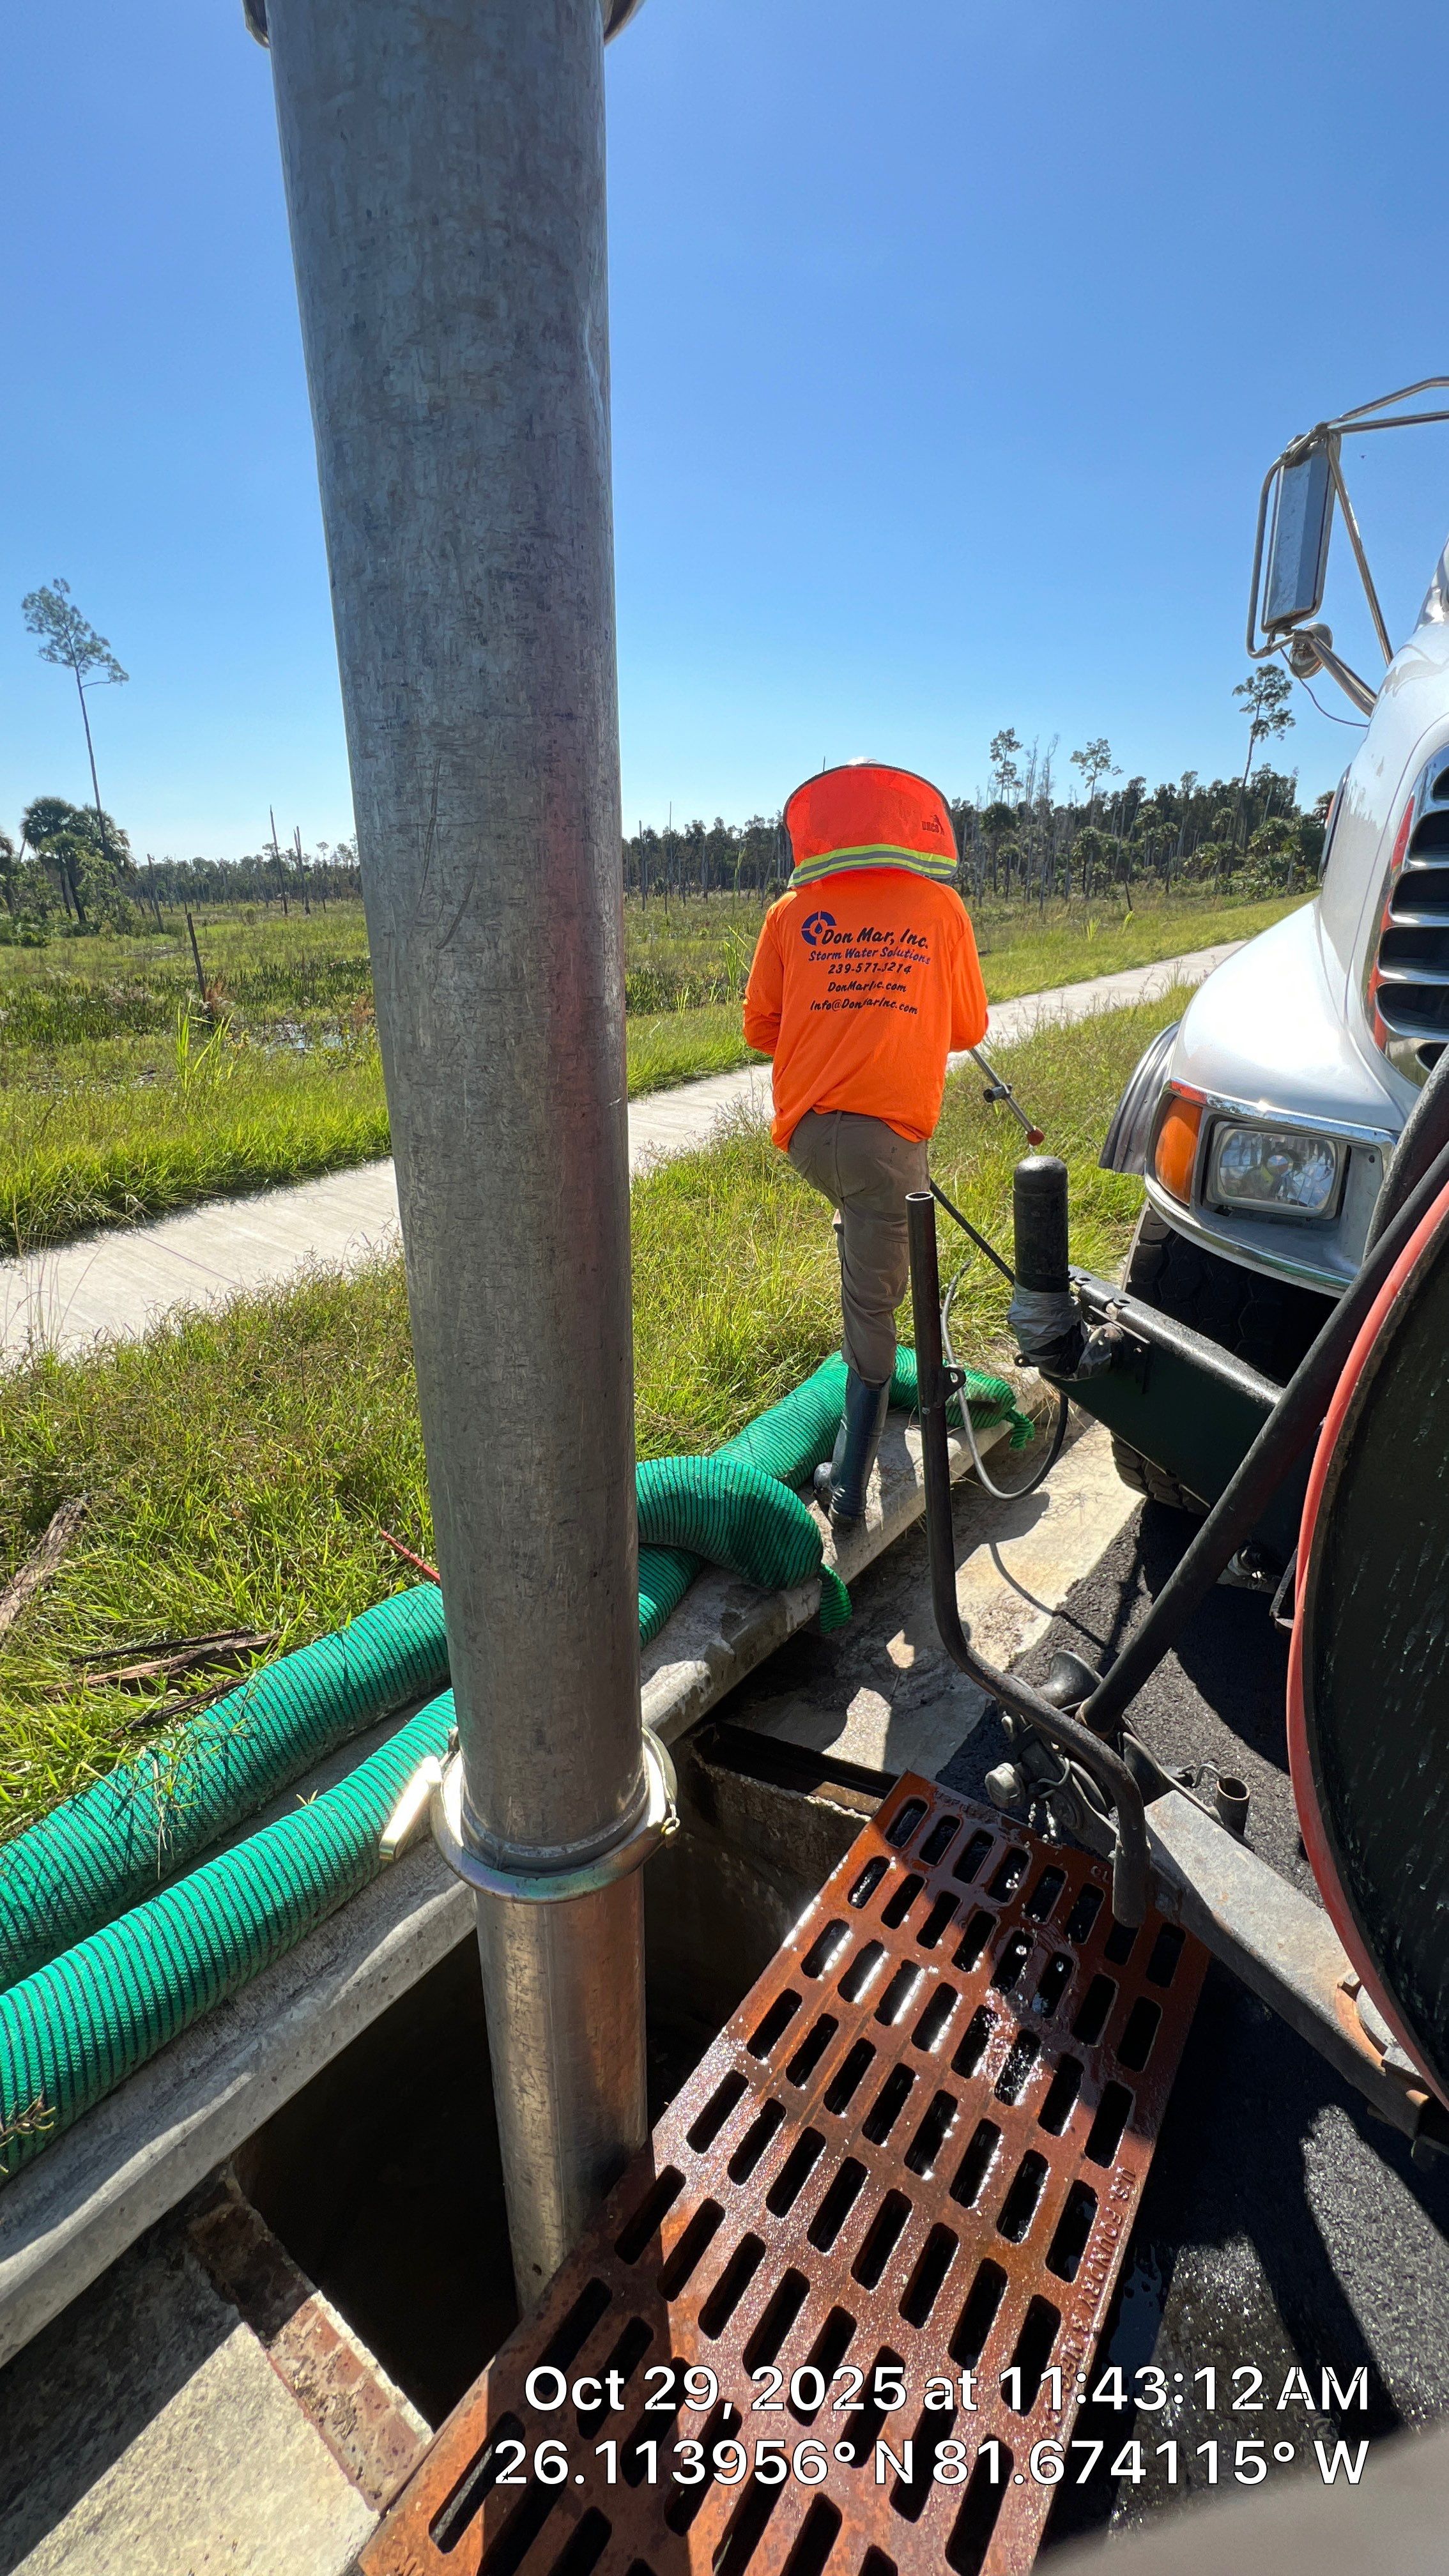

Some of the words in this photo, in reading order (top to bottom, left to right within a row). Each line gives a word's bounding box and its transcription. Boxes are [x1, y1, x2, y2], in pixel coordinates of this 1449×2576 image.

[822, 929, 854, 945] Don
[856, 927, 894, 946] Mar,
[900, 928, 929, 949] Inc.
[808, 950, 842, 962] Storm
[845, 948, 879, 959] Water
[880, 946, 931, 965] Solutions
[1077, 2207, 1122, 2312] FOUNDRY
